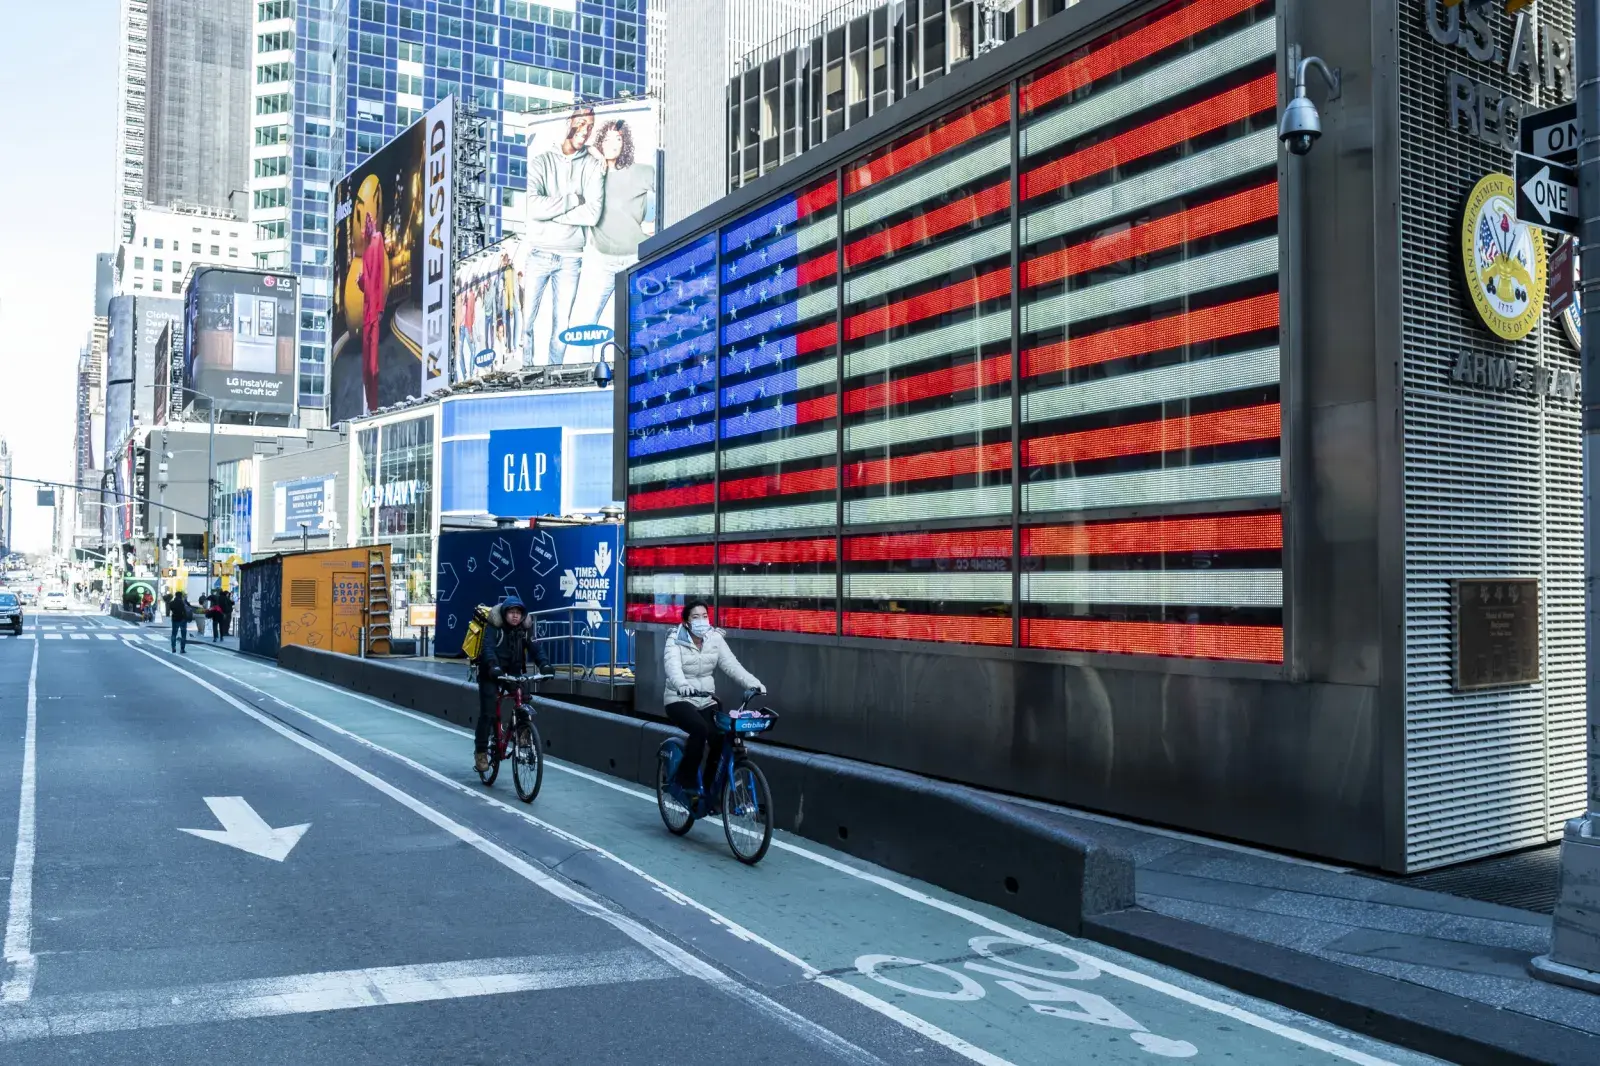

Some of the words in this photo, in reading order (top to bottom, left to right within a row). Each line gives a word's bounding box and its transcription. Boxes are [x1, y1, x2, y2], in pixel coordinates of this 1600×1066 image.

[1508, 13, 1576, 100] AR
[1548, 123, 1577, 151] ON
[1535, 180, 1568, 212] ONE
[1467, 181, 1504, 235] DEPARTMENT
[1507, 186, 1515, 198] O
[1531, 227, 1543, 264] ARMY
[426, 118, 446, 383] RELEASED
[276, 278, 290, 287] LG
[1466, 248, 1483, 302] UNITED
[1483, 304, 1512, 333] STATES
[1514, 321, 1523, 333] OF
[1523, 276, 1543, 326] AMERICA
[1497, 301, 1514, 313] 1775
[564, 331, 582, 342] OLD
[583, 330, 608, 341] NAVY
[226, 377, 239, 386] LG
[1453, 350, 1518, 389] ARMY
[243, 387, 264, 396] Craft
[503, 452, 547, 493] GAP
[362, 484, 385, 508] OLD
[385, 480, 418, 507] NAVY
[575, 567, 597, 578] TIMES
[578, 578, 610, 589] SQUARE
[575, 590, 608, 601] MARKET
